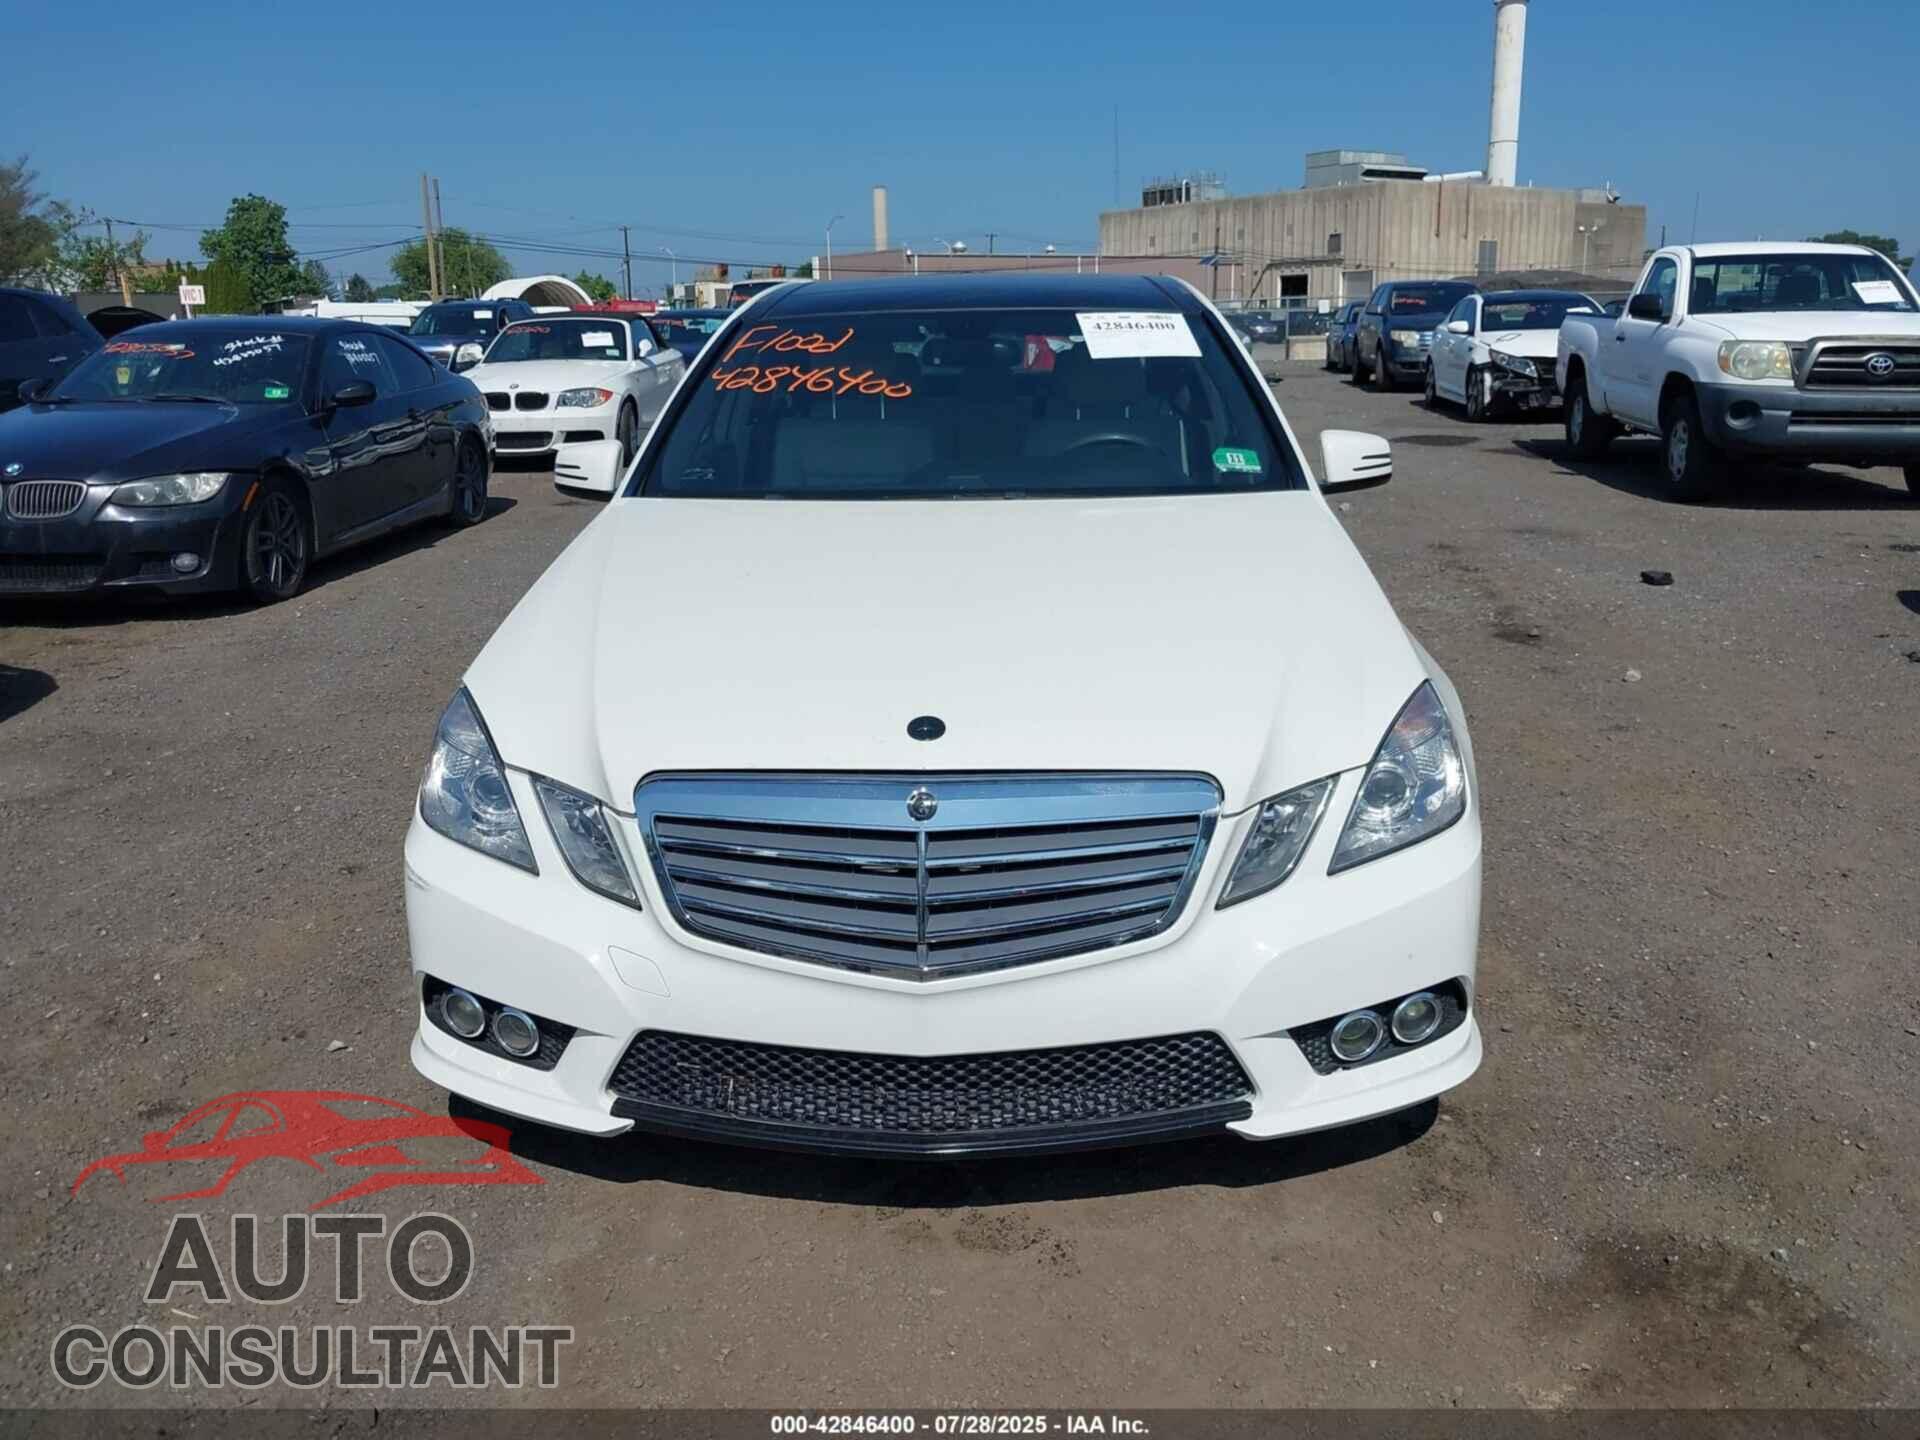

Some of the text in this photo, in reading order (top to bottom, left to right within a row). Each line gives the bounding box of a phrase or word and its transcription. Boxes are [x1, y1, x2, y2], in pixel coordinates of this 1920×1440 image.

[1094, 321, 1176, 331] 42846400
[723, 325, 855, 363] Flood
[712, 365, 912, 398] 42846400
